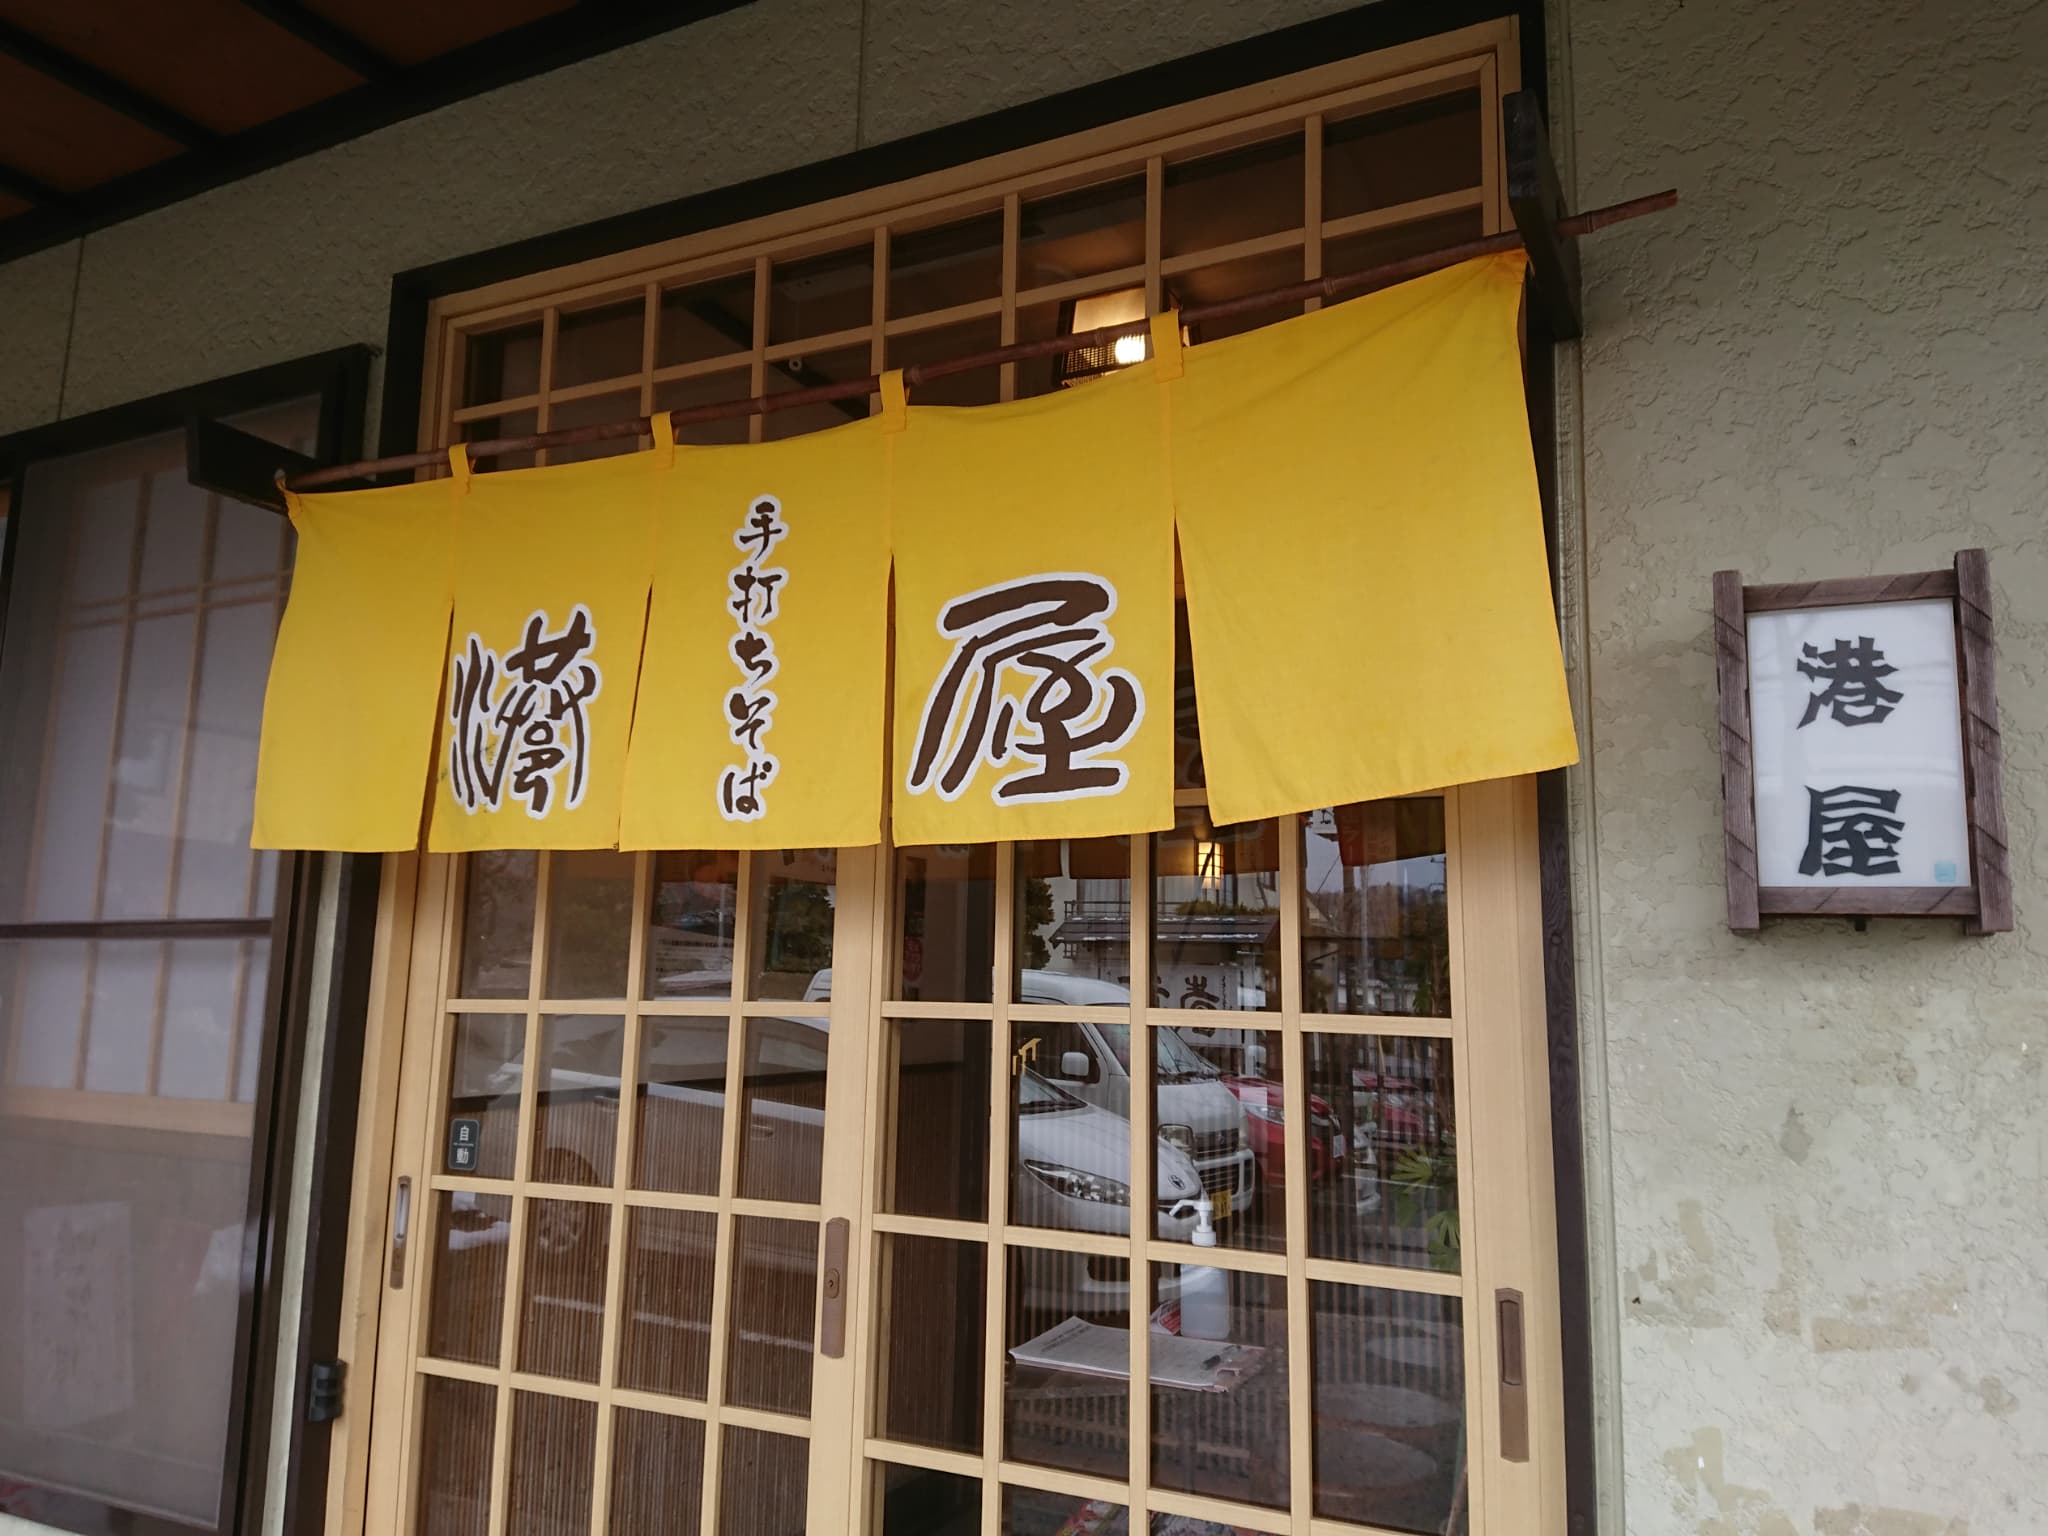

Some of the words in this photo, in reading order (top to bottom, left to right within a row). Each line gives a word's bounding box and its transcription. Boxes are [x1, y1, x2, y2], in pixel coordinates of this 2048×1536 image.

[721, 498, 785, 816] 手打ちそば
[1795, 634, 1906, 878] 港屋
